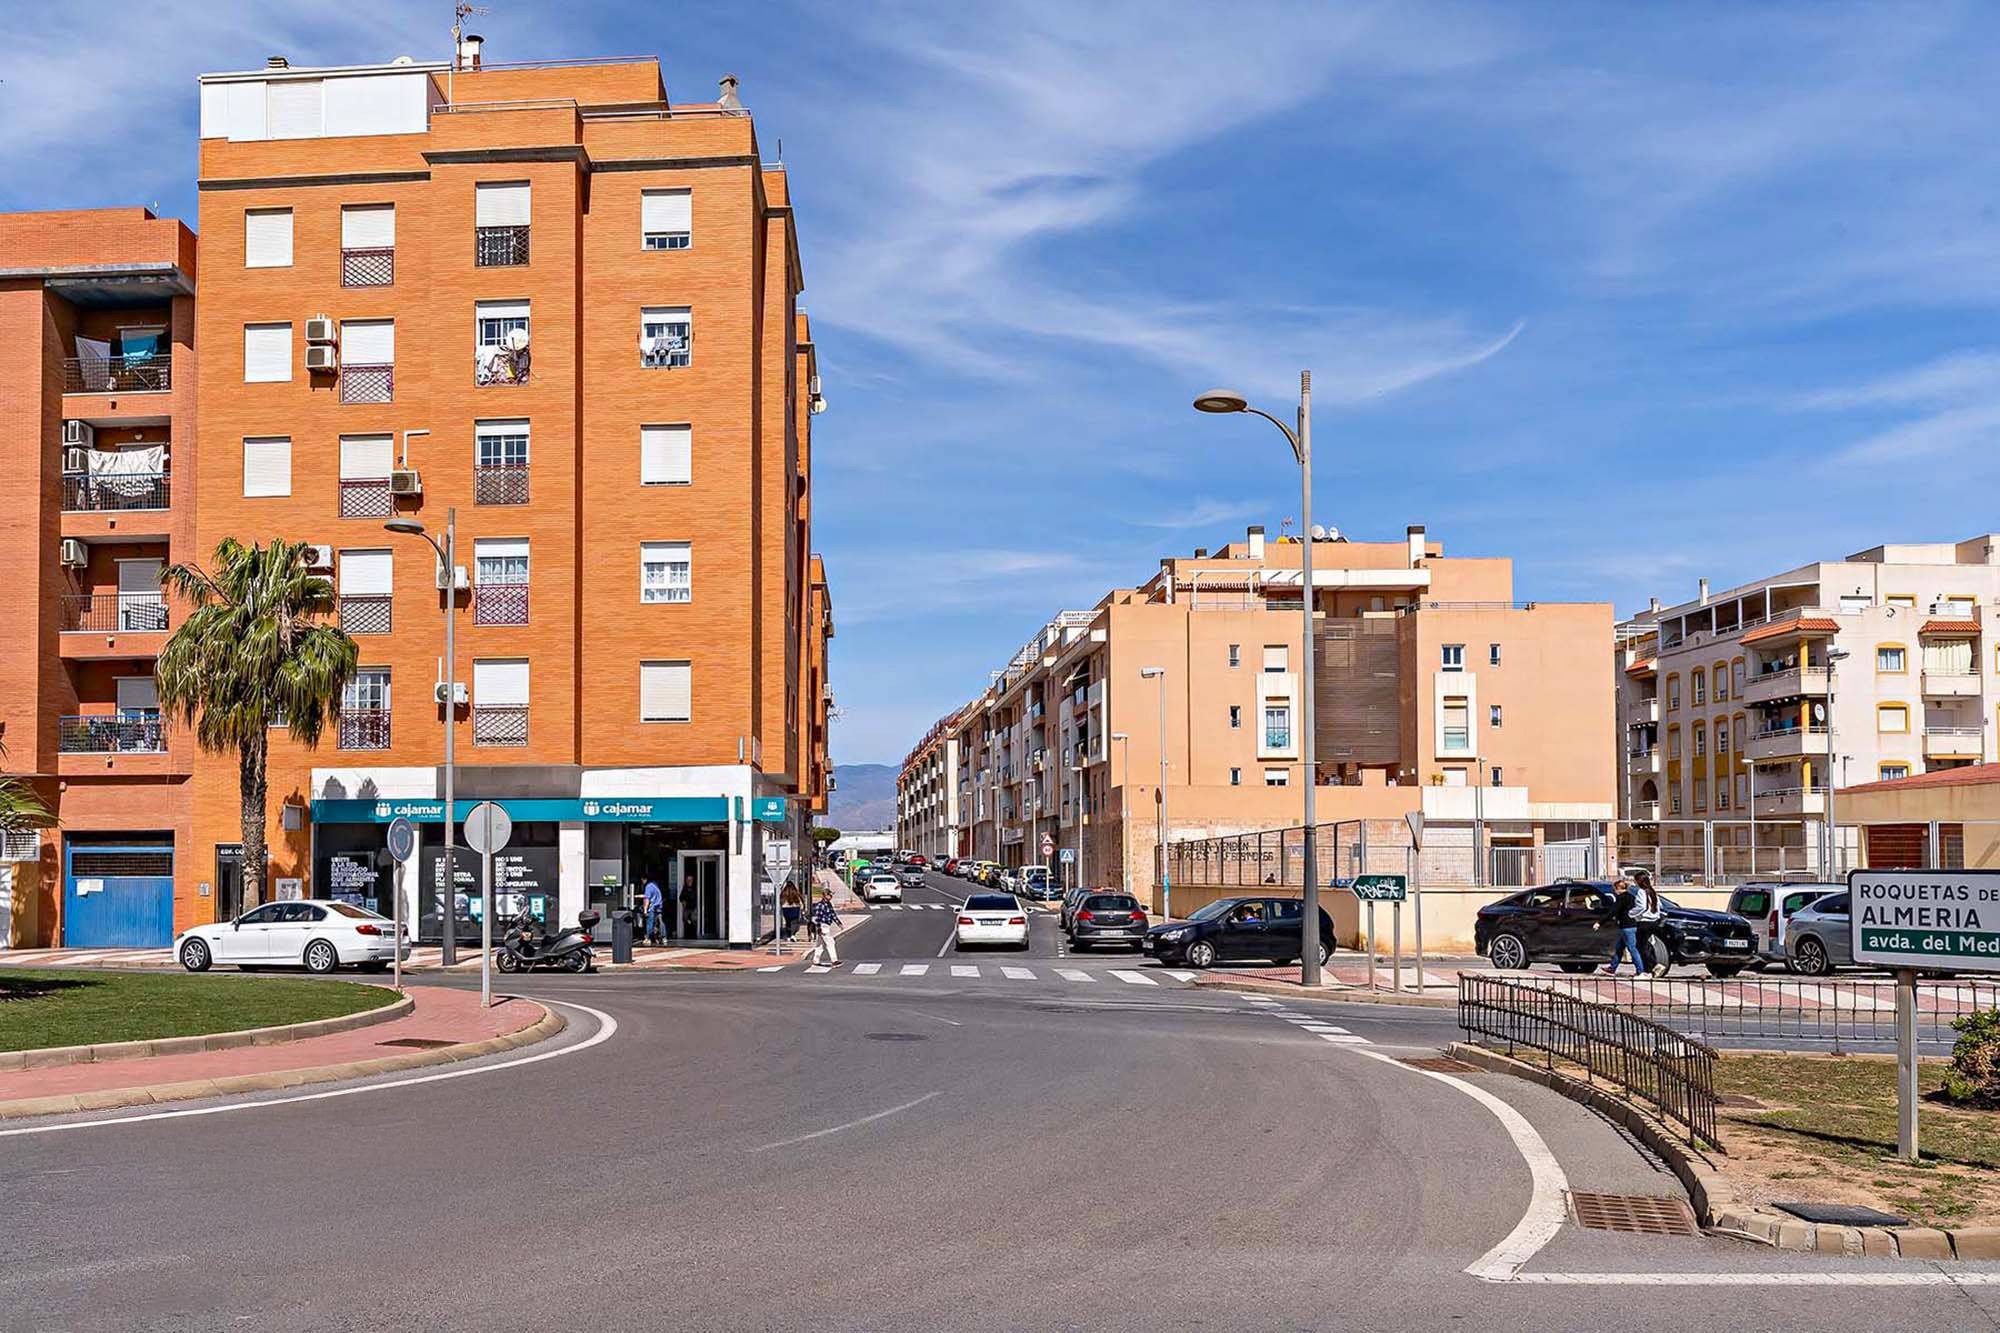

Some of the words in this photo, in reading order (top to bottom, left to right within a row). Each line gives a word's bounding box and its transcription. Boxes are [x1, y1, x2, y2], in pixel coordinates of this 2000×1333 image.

[394, 803, 443, 817] cajamar
[602, 802, 653, 817] cajamar
[1860, 884, 1969, 901] ROQUETAS
[1979, 889, 1999, 901] DE
[1861, 906, 1981, 928] ALMERIA
[1869, 933, 1915, 949] avda.
[1922, 935, 1951, 951] del
[1959, 936, 2000, 953] Med
